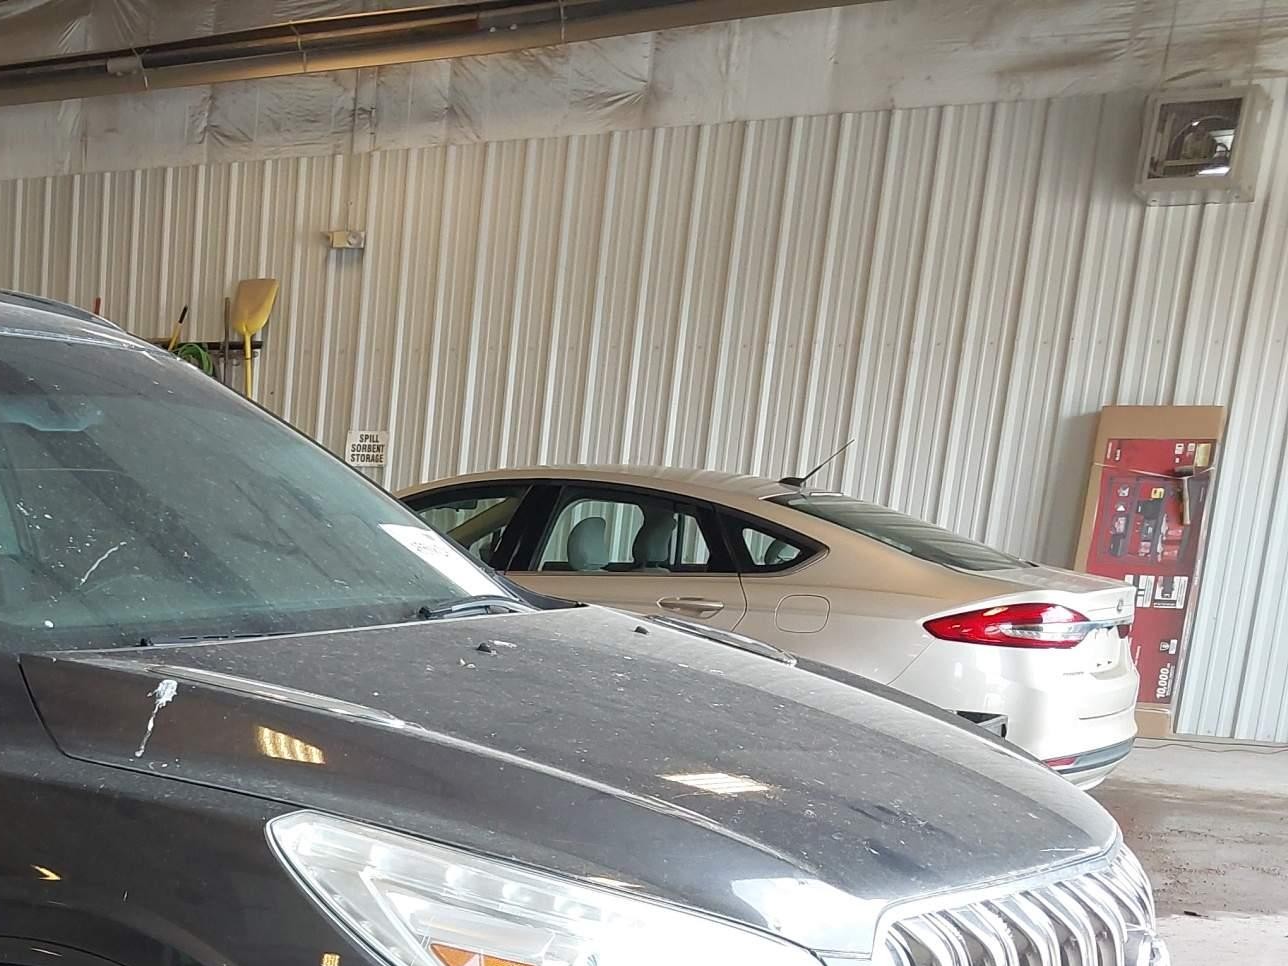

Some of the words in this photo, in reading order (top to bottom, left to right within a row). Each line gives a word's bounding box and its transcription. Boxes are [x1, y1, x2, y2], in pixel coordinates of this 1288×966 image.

[359, 433, 380, 443] SPILL
[350, 443, 385, 453] SORBENT
[350, 454, 384, 463] STORAGE
[1156, 667, 1170, 699] 10,000
